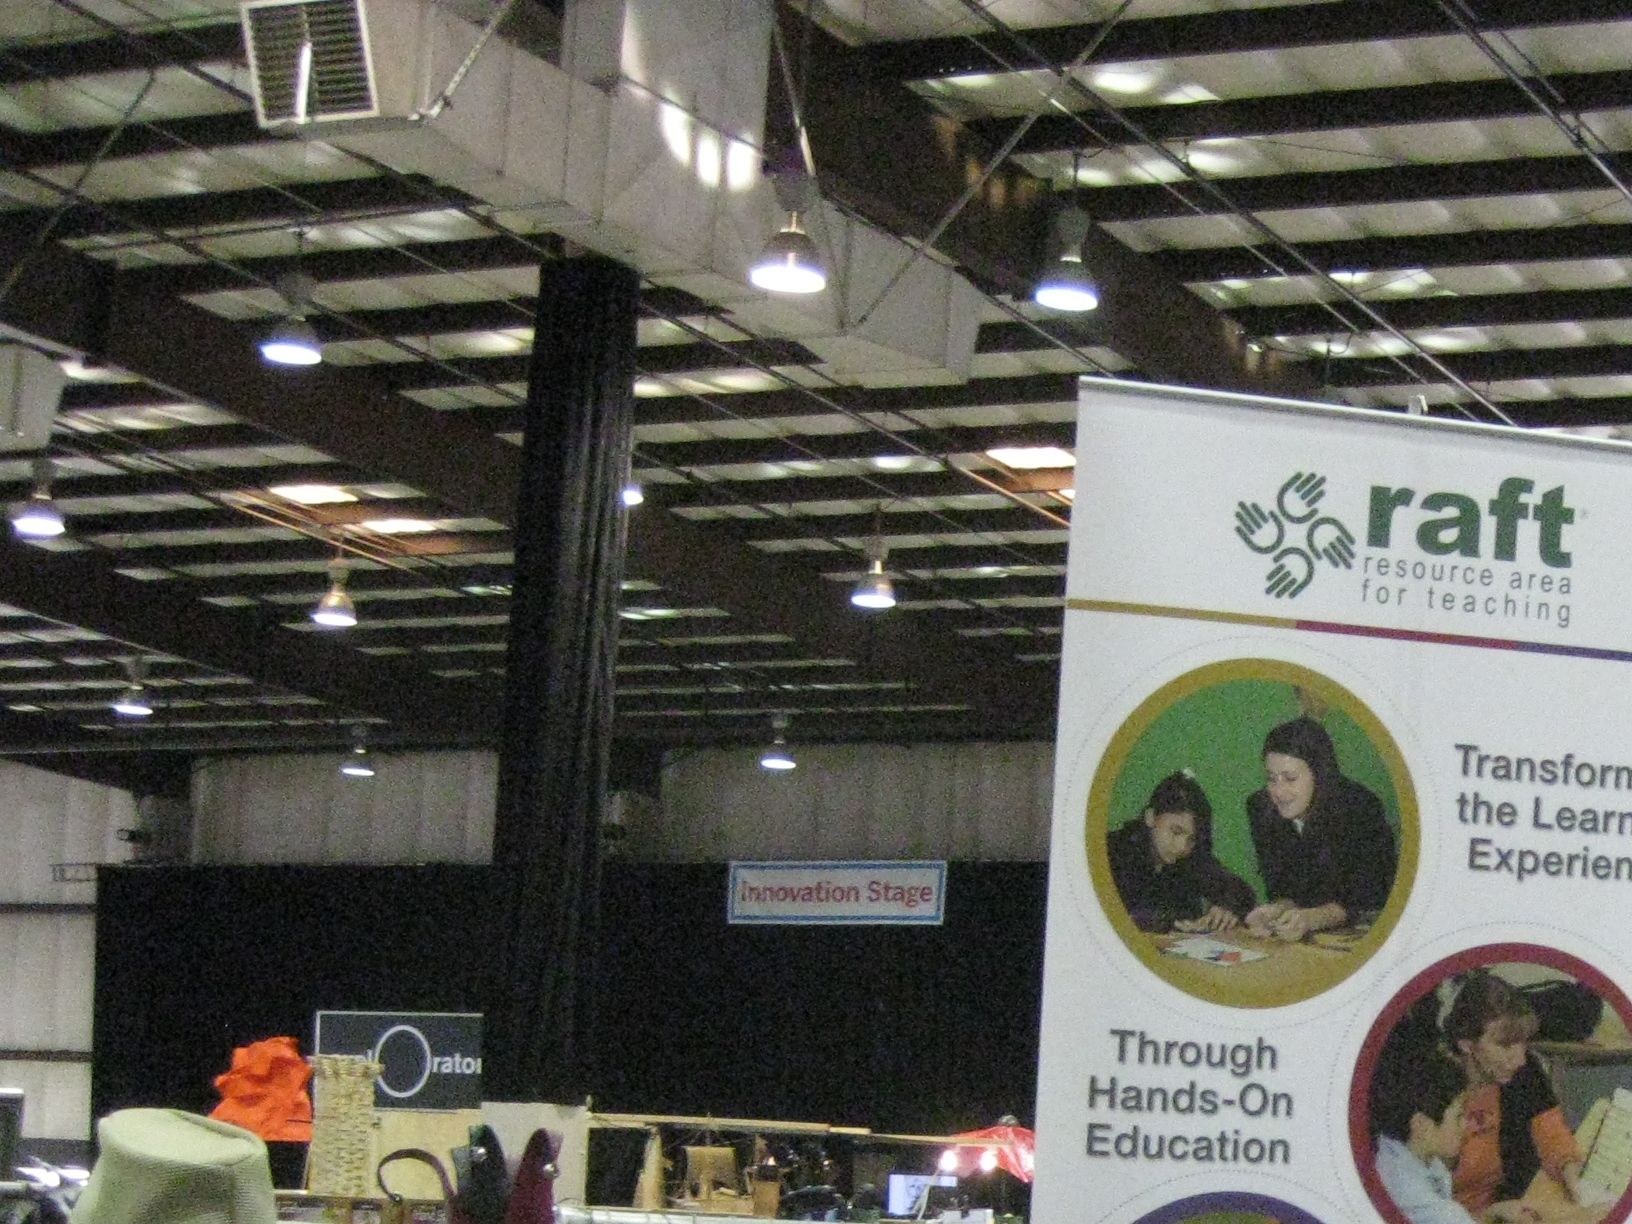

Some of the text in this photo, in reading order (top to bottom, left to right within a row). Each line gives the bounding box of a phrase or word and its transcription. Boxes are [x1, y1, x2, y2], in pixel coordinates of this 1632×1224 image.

[1367, 477, 1575, 568] raft
[1364, 555, 1572, 595] resource area
[1362, 579, 1571, 628] for teaching
[1457, 792, 1518, 826] the
[741, 880, 933, 908] Innovation Stage
[1110, 1028, 1278, 1077] Through
[1088, 1075, 1294, 1118] Hands-On
[1086, 1122, 1290, 1164] Education
